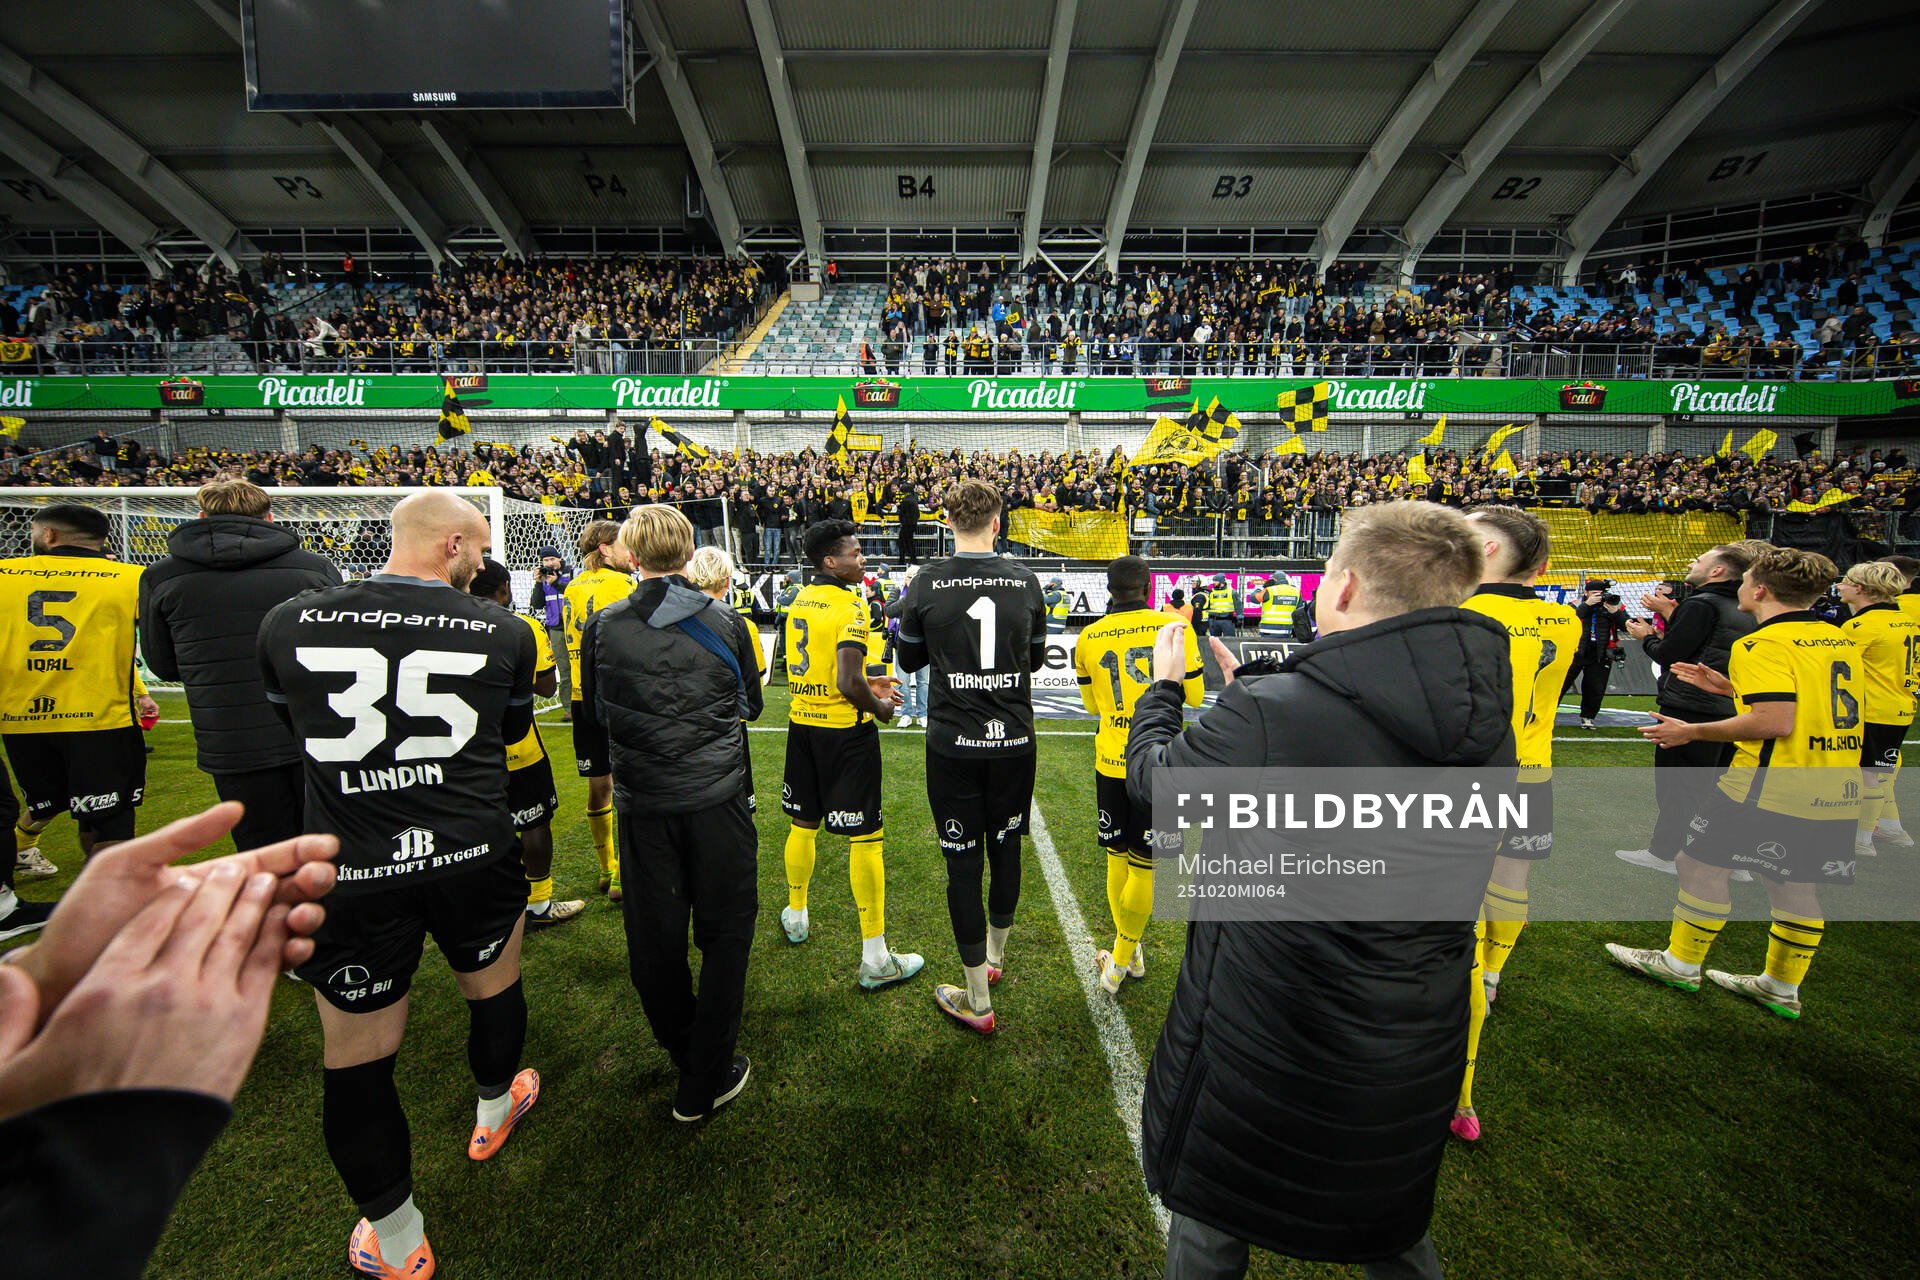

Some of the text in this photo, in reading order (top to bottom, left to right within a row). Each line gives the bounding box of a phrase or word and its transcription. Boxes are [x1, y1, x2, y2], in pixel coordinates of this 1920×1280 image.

[413, 92, 457, 102] SAMSUNG
[1708, 151, 1768, 182] B1
[273, 175, 324, 200] P3
[584, 173, 628, 198] P4
[898, 174, 936, 199] B4
[1211, 174, 1253, 199] B3
[1492, 176, 1542, 201] B2
[258, 376, 366, 407] Picadeli
[611, 377, 721, 407] Picadeli
[967, 379, 1077, 409] Picadeli
[1326, 380, 1428, 410] Picadeli
[1670, 382, 1779, 412] Picadeli
[932, 576, 1028, 590] Kundpartner
[27, 590, 78, 652] 5
[299, 608, 497, 634] Kundpartner
[966, 596, 996, 670] 1
[789, 617, 810, 677] 3
[947, 672, 1021, 691] TÖRNQVIST
[28, 696, 56, 714] JB
[296, 646, 488, 762] 35
[1830, 660, 1860, 730] 6
[51, 711, 94, 719] BYGGER
[955, 734, 1029, 748] JÄRLETOFT BYGGER
[985, 721, 1006, 740] JB
[340, 763, 443, 794] LUNDIN
[131, 788, 143, 801] 5
[828, 810, 865, 828] EXTRA
[392, 829, 435, 862] JB
[1144, 828, 1183, 849] EXTRA
[337, 843, 490, 882] JÄRLETOFT BYGGER
[372, 979, 393, 996] Bil
